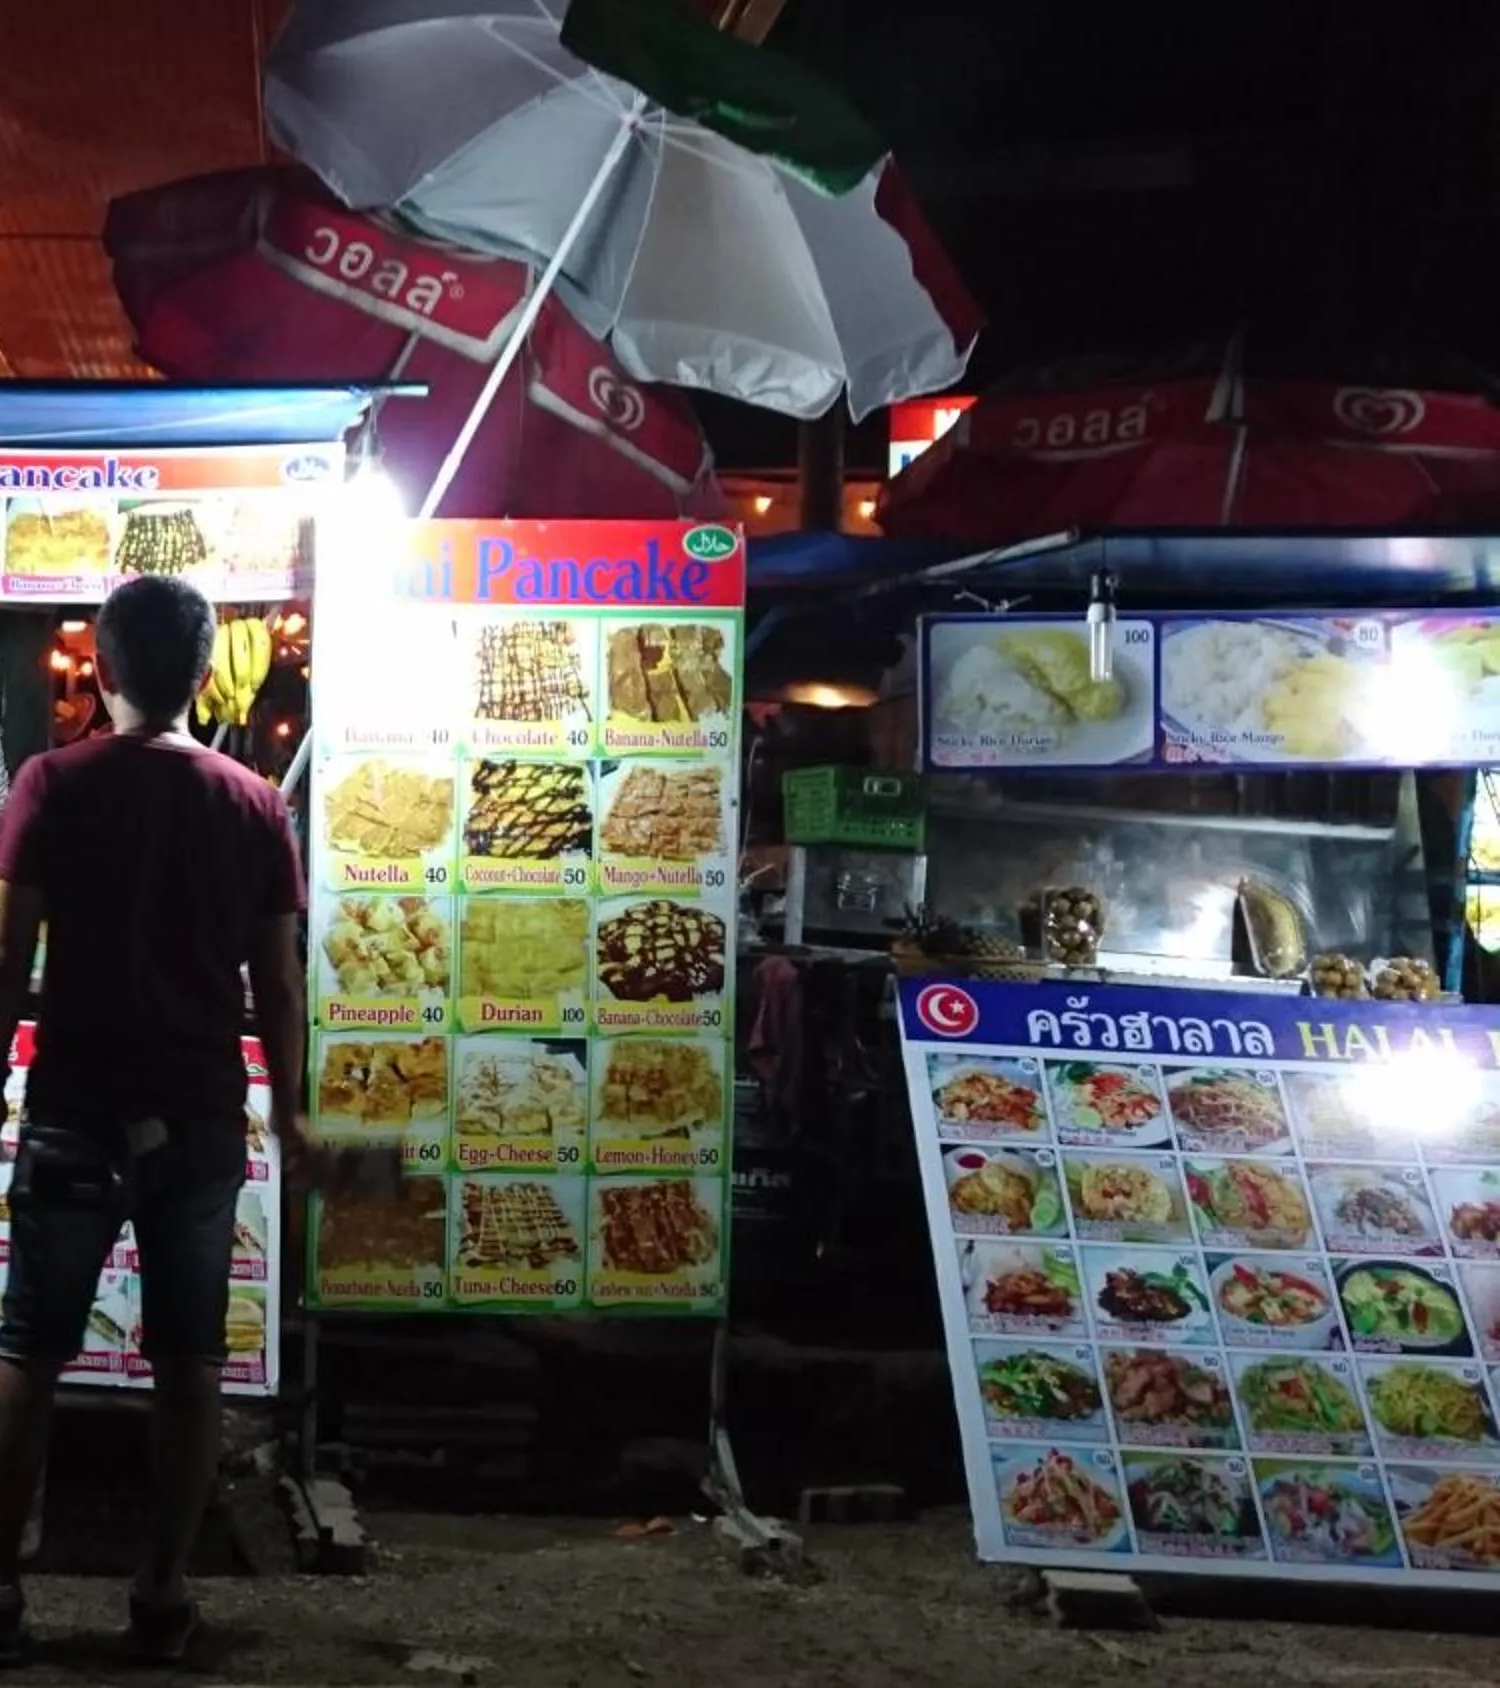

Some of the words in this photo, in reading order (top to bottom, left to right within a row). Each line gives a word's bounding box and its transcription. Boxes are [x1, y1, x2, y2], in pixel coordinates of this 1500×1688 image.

[478, 538, 710, 601] Pancake
[1124, 630, 1149, 644] 100
[472, 728, 559, 746] Chocolate
[566, 729, 589, 746] 40
[709, 731, 728, 748] 50
[344, 864, 409, 883] Nutella
[425, 867, 447, 884] 40
[564, 868, 586, 886] 50
[705, 869, 726, 887] 50
[328, 1003, 414, 1025] Pineapple
[422, 1006, 445, 1022] 40
[481, 1004, 543, 1022] Durian
[561, 1007, 585, 1023] 100
[700, 1009, 721, 1027] 50
[1027, 996, 1275, 1057] ครัวฮาลาล
[419, 1144, 440, 1161] 60
[458, 1144, 552, 1164] Egg-Cheese
[557, 1146, 579, 1163] 50
[595, 1147, 699, 1167] Lemon-Honey
[699, 1148, 719, 1165] 50
[423, 1281, 443, 1298] 50
[455, 1276, 555, 1295] Tuna-Cheese
[555, 1279, 576, 1296] 60
